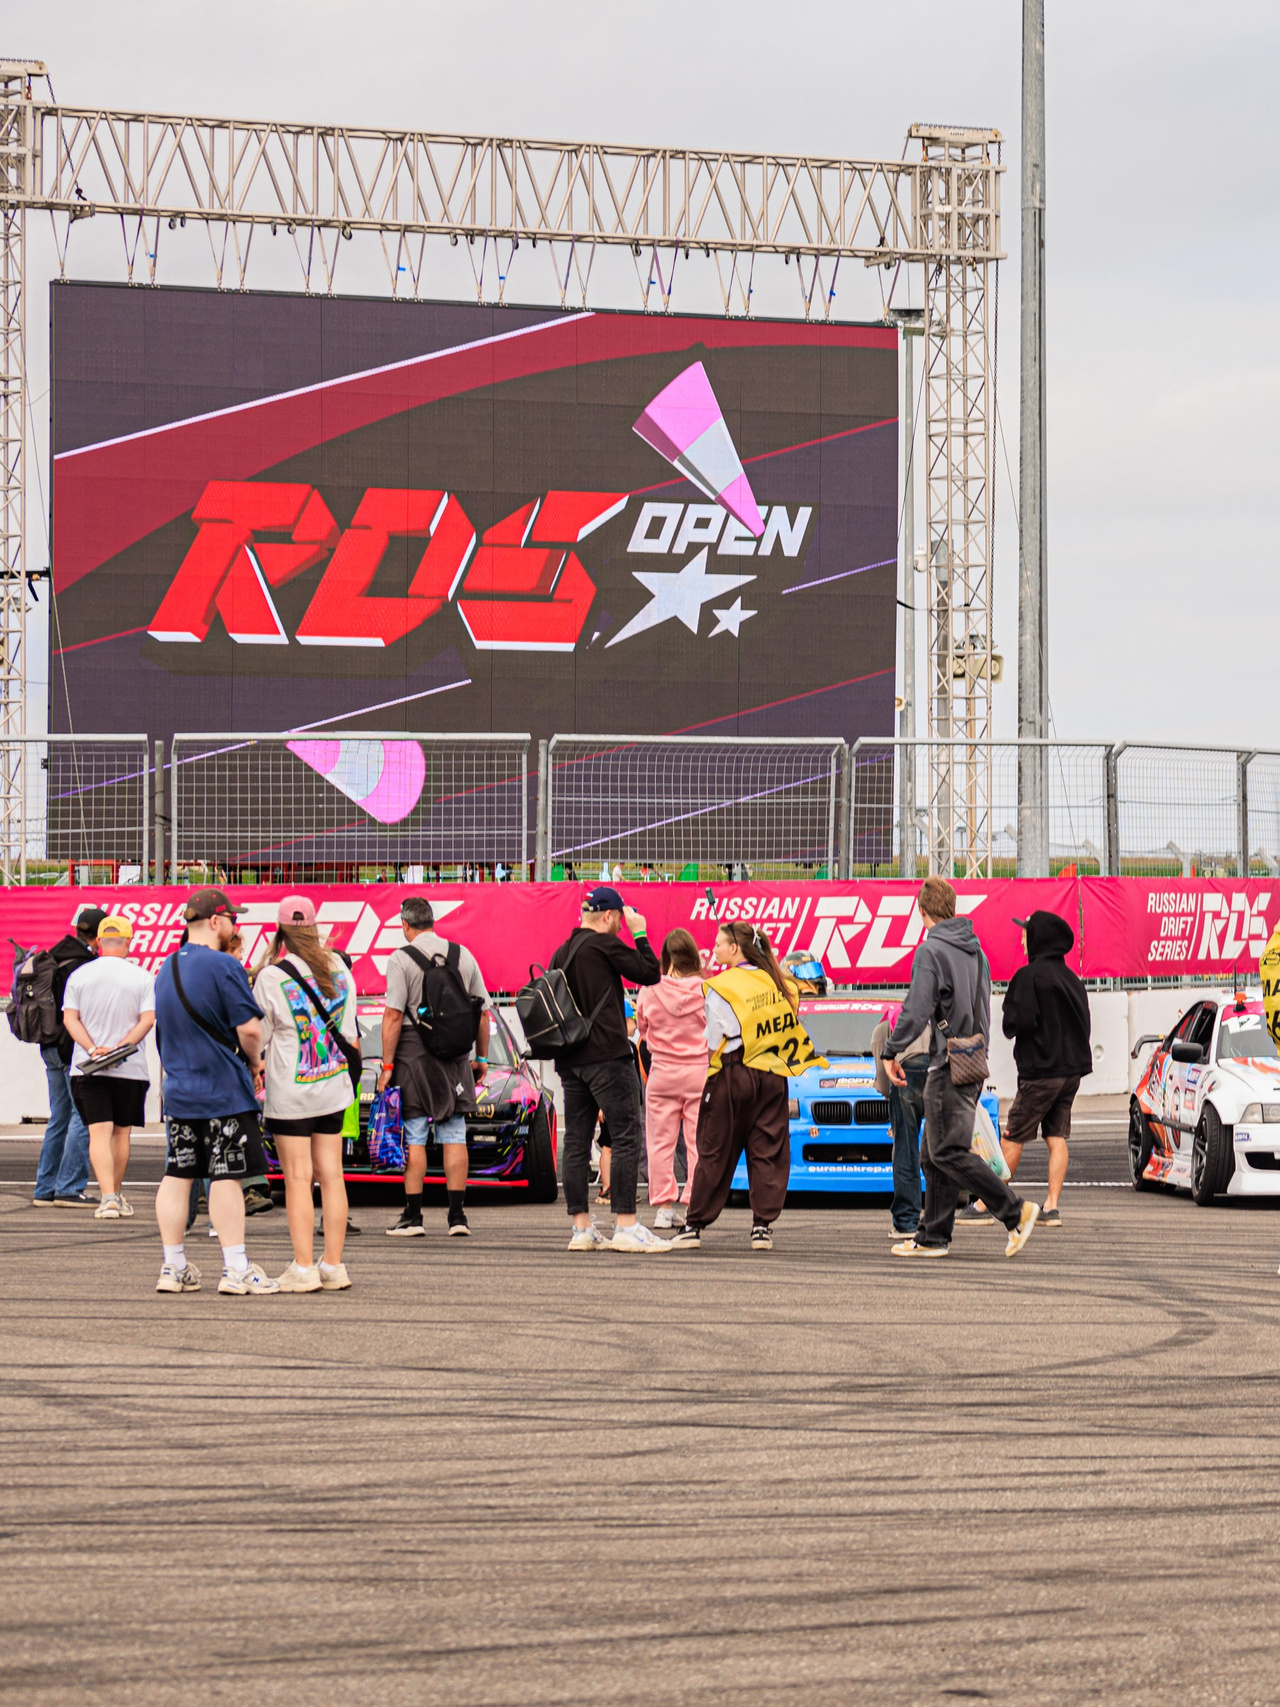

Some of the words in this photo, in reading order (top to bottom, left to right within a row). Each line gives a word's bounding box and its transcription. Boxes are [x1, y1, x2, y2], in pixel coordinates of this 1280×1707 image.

[626, 501, 813, 557] OPEN
[146, 479, 630, 653] RDS
[690, 896, 801, 921] RUSSIAN
[1146, 892, 1196, 914] RUSSIAN
[1197, 891, 1272, 960] RDS
[1159, 916, 1194, 937] DRIFT
[1147, 939, 1189, 962] SERIES
[1221, 1013, 1262, 1035] 12
